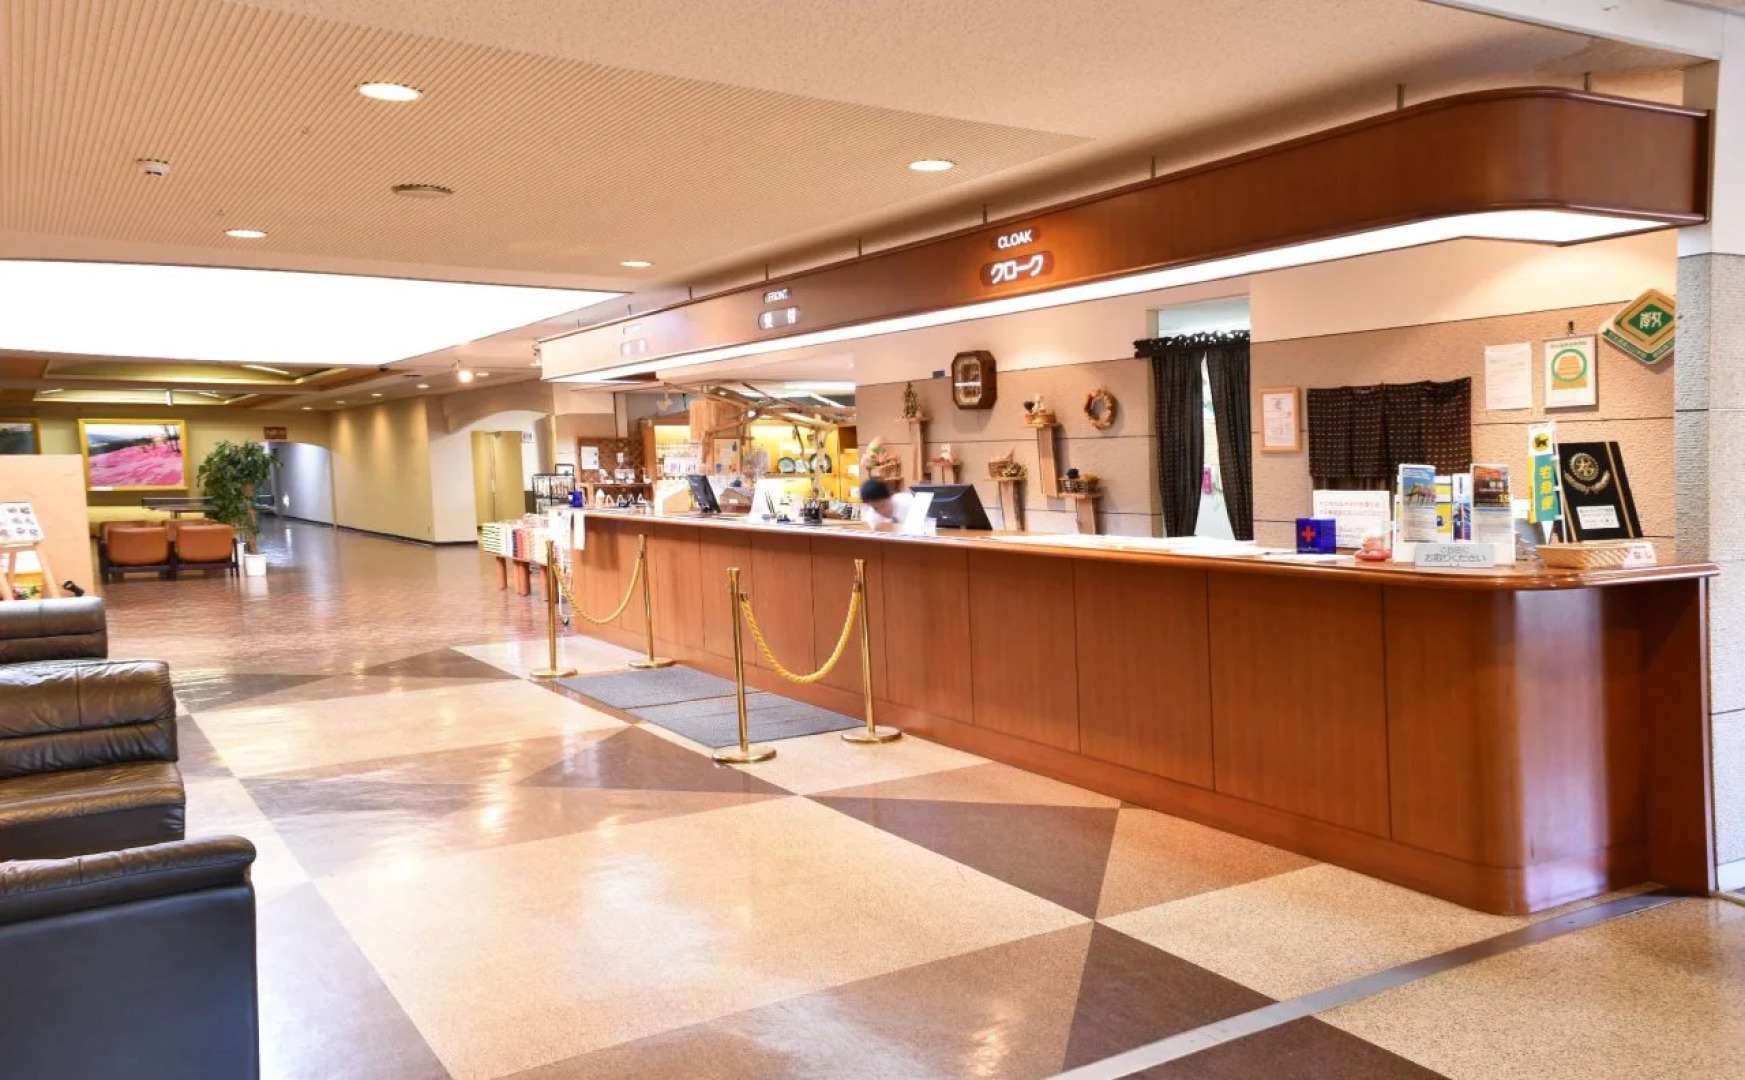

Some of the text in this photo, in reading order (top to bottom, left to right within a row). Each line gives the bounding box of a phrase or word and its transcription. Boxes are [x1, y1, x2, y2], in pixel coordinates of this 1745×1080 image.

[997, 228, 1033, 249] CLOAK
[990, 254, 1044, 284] クローク
